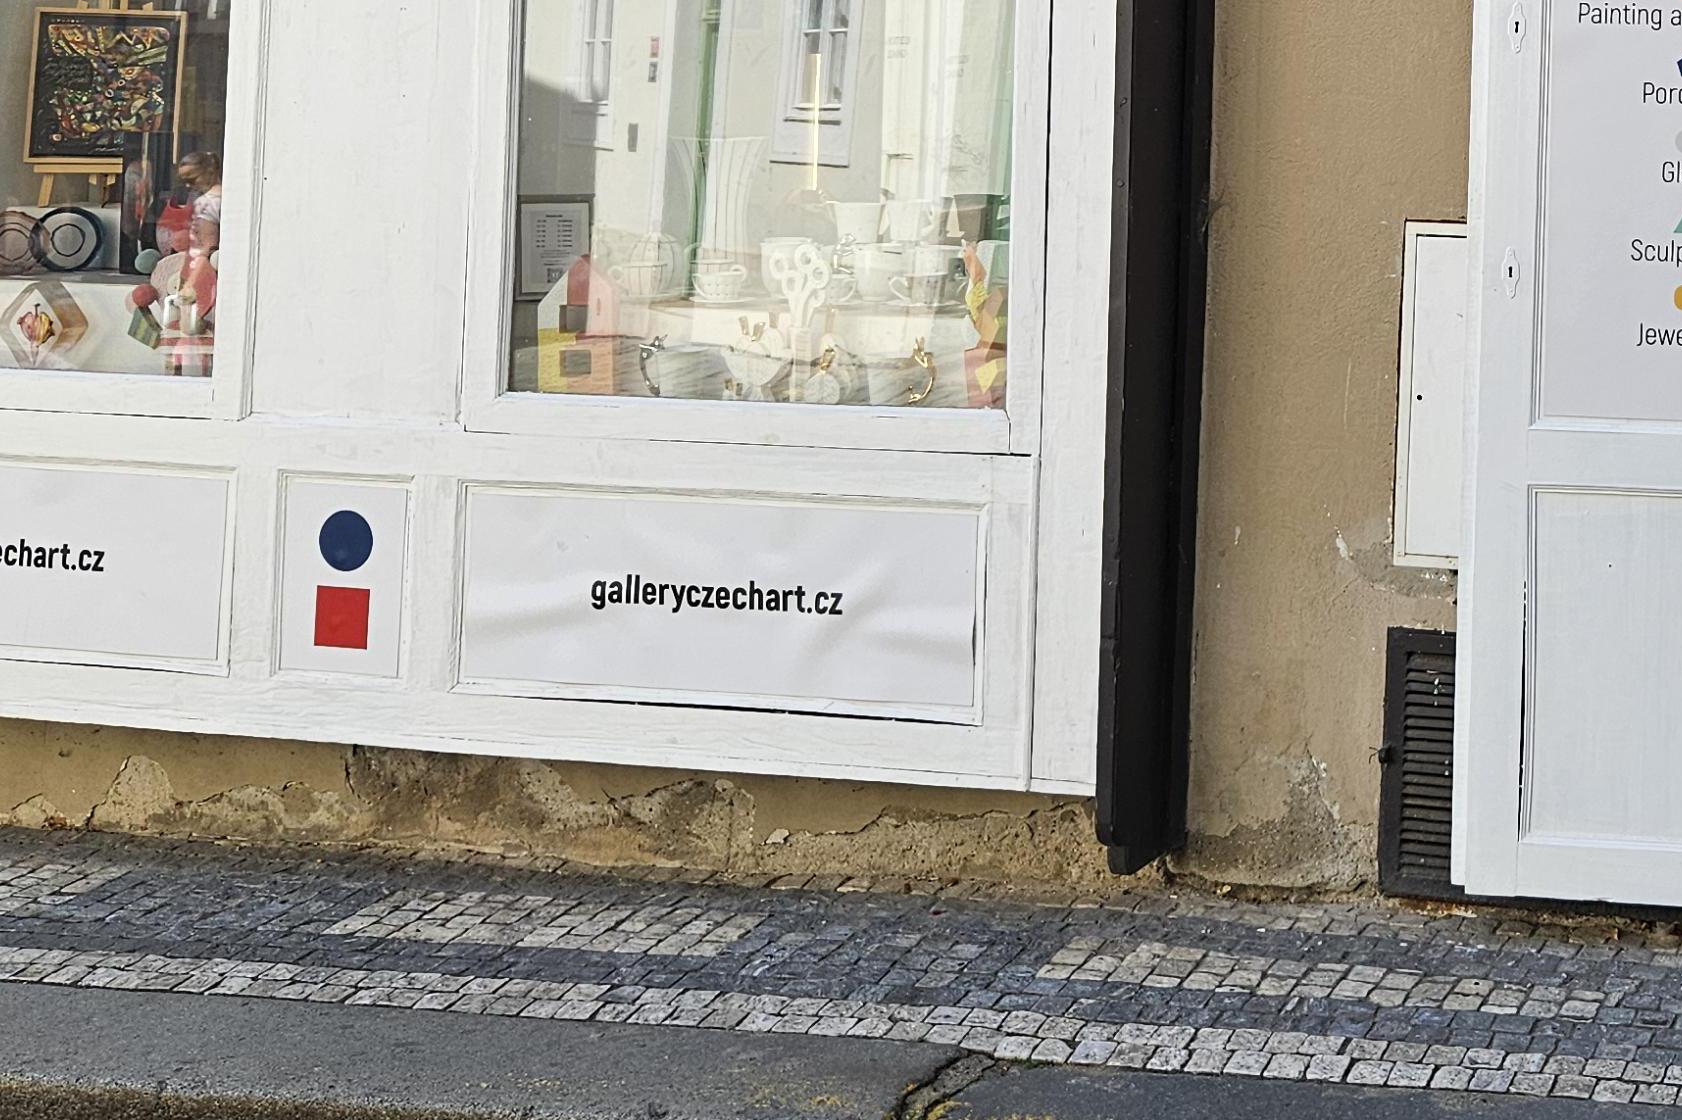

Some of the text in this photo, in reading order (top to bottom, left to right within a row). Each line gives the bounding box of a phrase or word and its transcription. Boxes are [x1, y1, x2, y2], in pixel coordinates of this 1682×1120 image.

[1579, 3, 1661, 30] Painting
[0, 539, 104, 571] chart.cz
[592, 574, 842, 615] galleryczechart.cz
